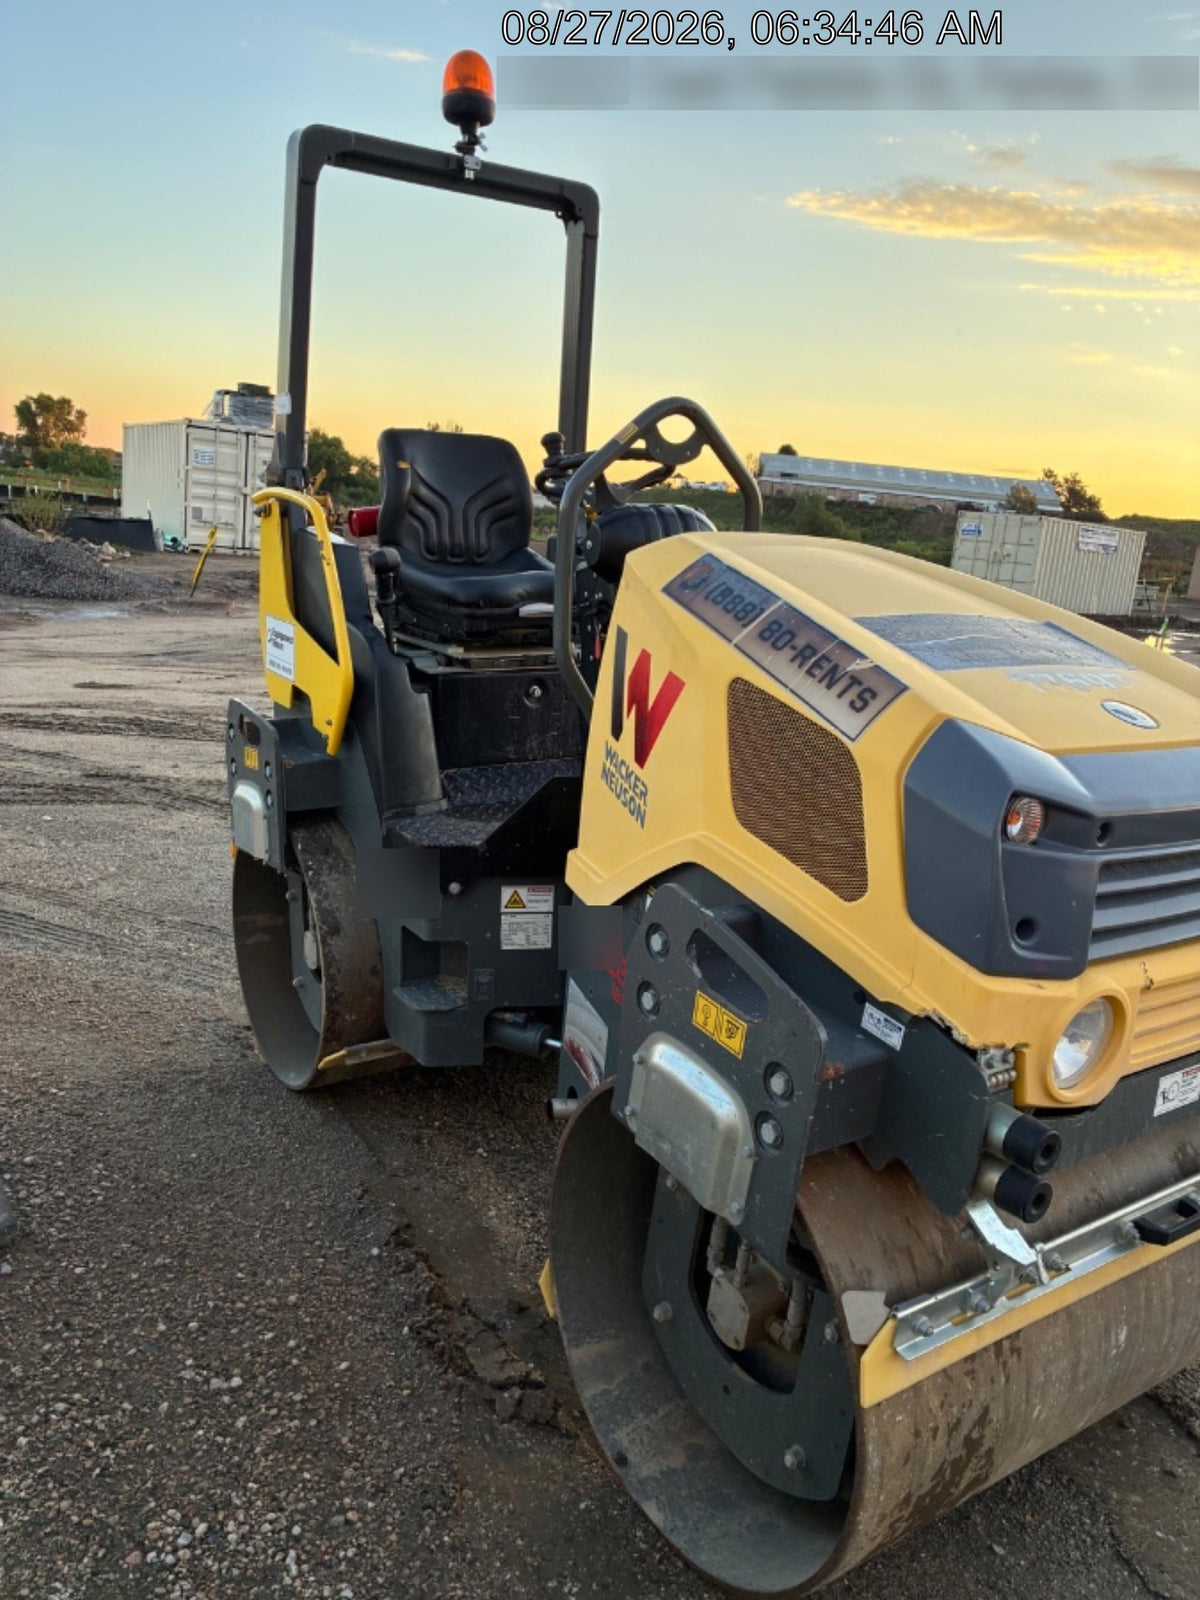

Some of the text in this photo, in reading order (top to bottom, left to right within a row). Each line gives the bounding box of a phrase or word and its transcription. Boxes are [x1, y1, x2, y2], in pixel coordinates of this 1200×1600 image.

[757, 619, 878, 714] 80-RENTS
[600, 762, 647, 829] NEUSON
[604, 739, 649, 807] WACKER
